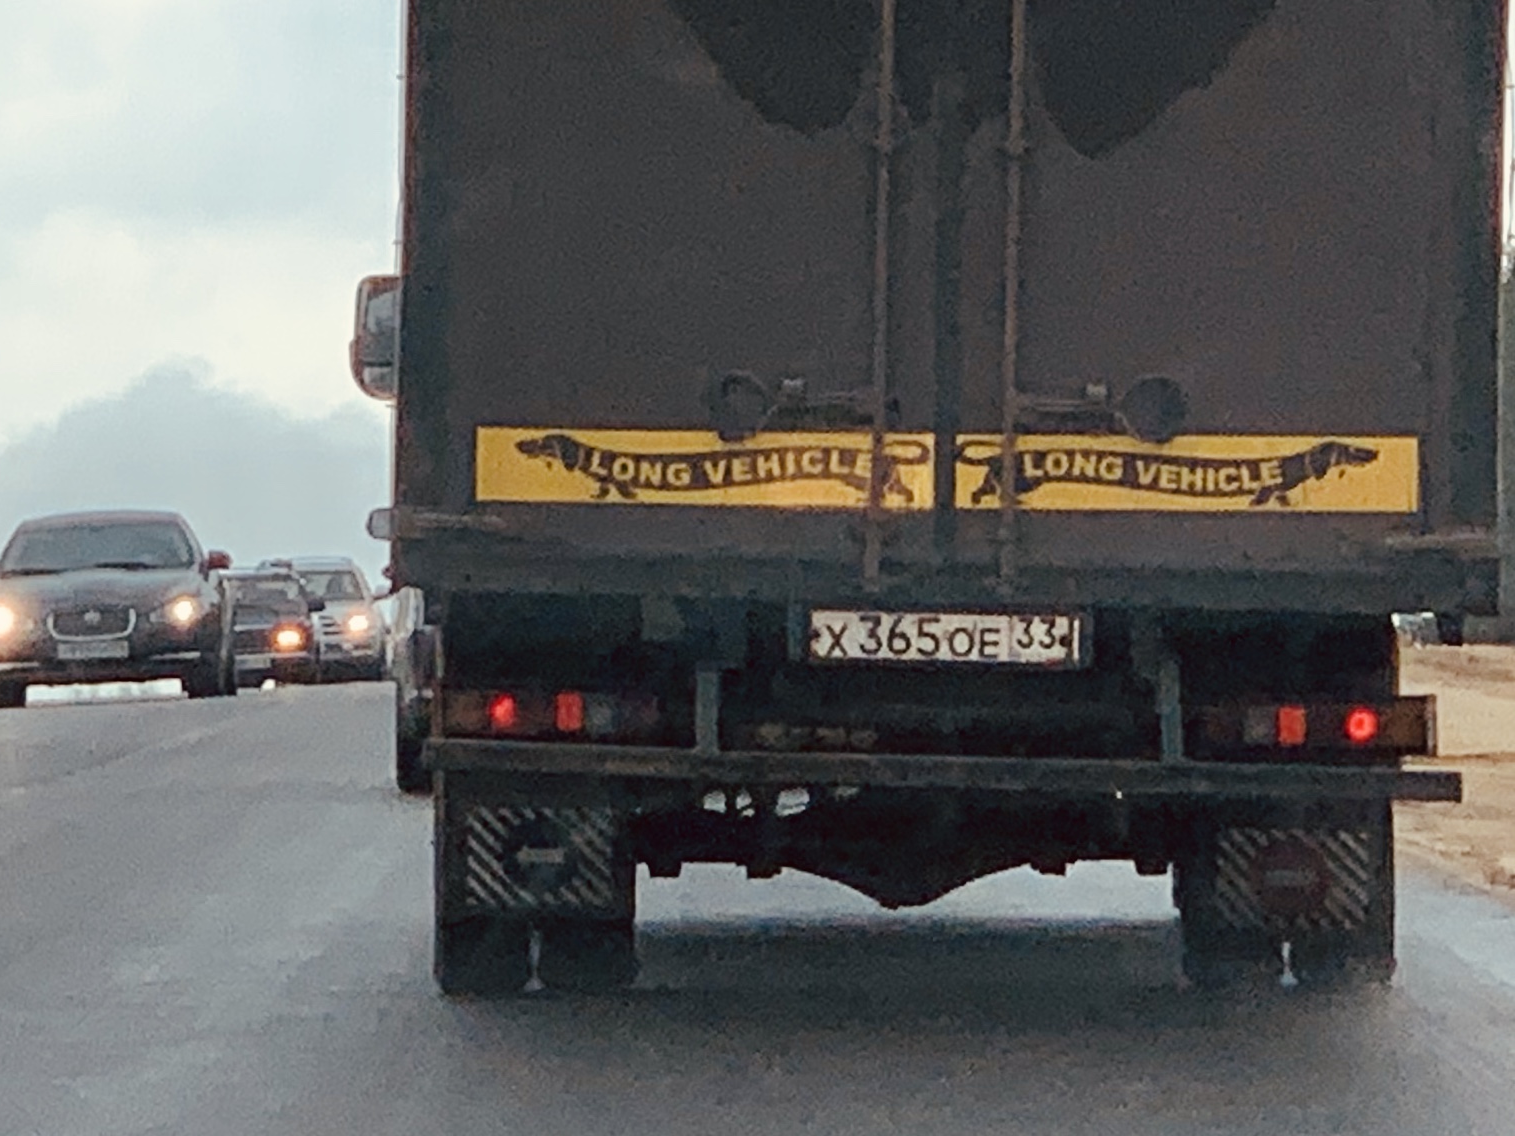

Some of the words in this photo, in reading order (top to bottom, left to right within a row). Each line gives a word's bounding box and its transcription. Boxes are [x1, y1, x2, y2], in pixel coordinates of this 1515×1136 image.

[588, 449, 691, 485] LONG
[704, 448, 872, 484] VEHICLE
[1023, 452, 1124, 480] LONG
[1136, 459, 1283, 492] VEHICLE
